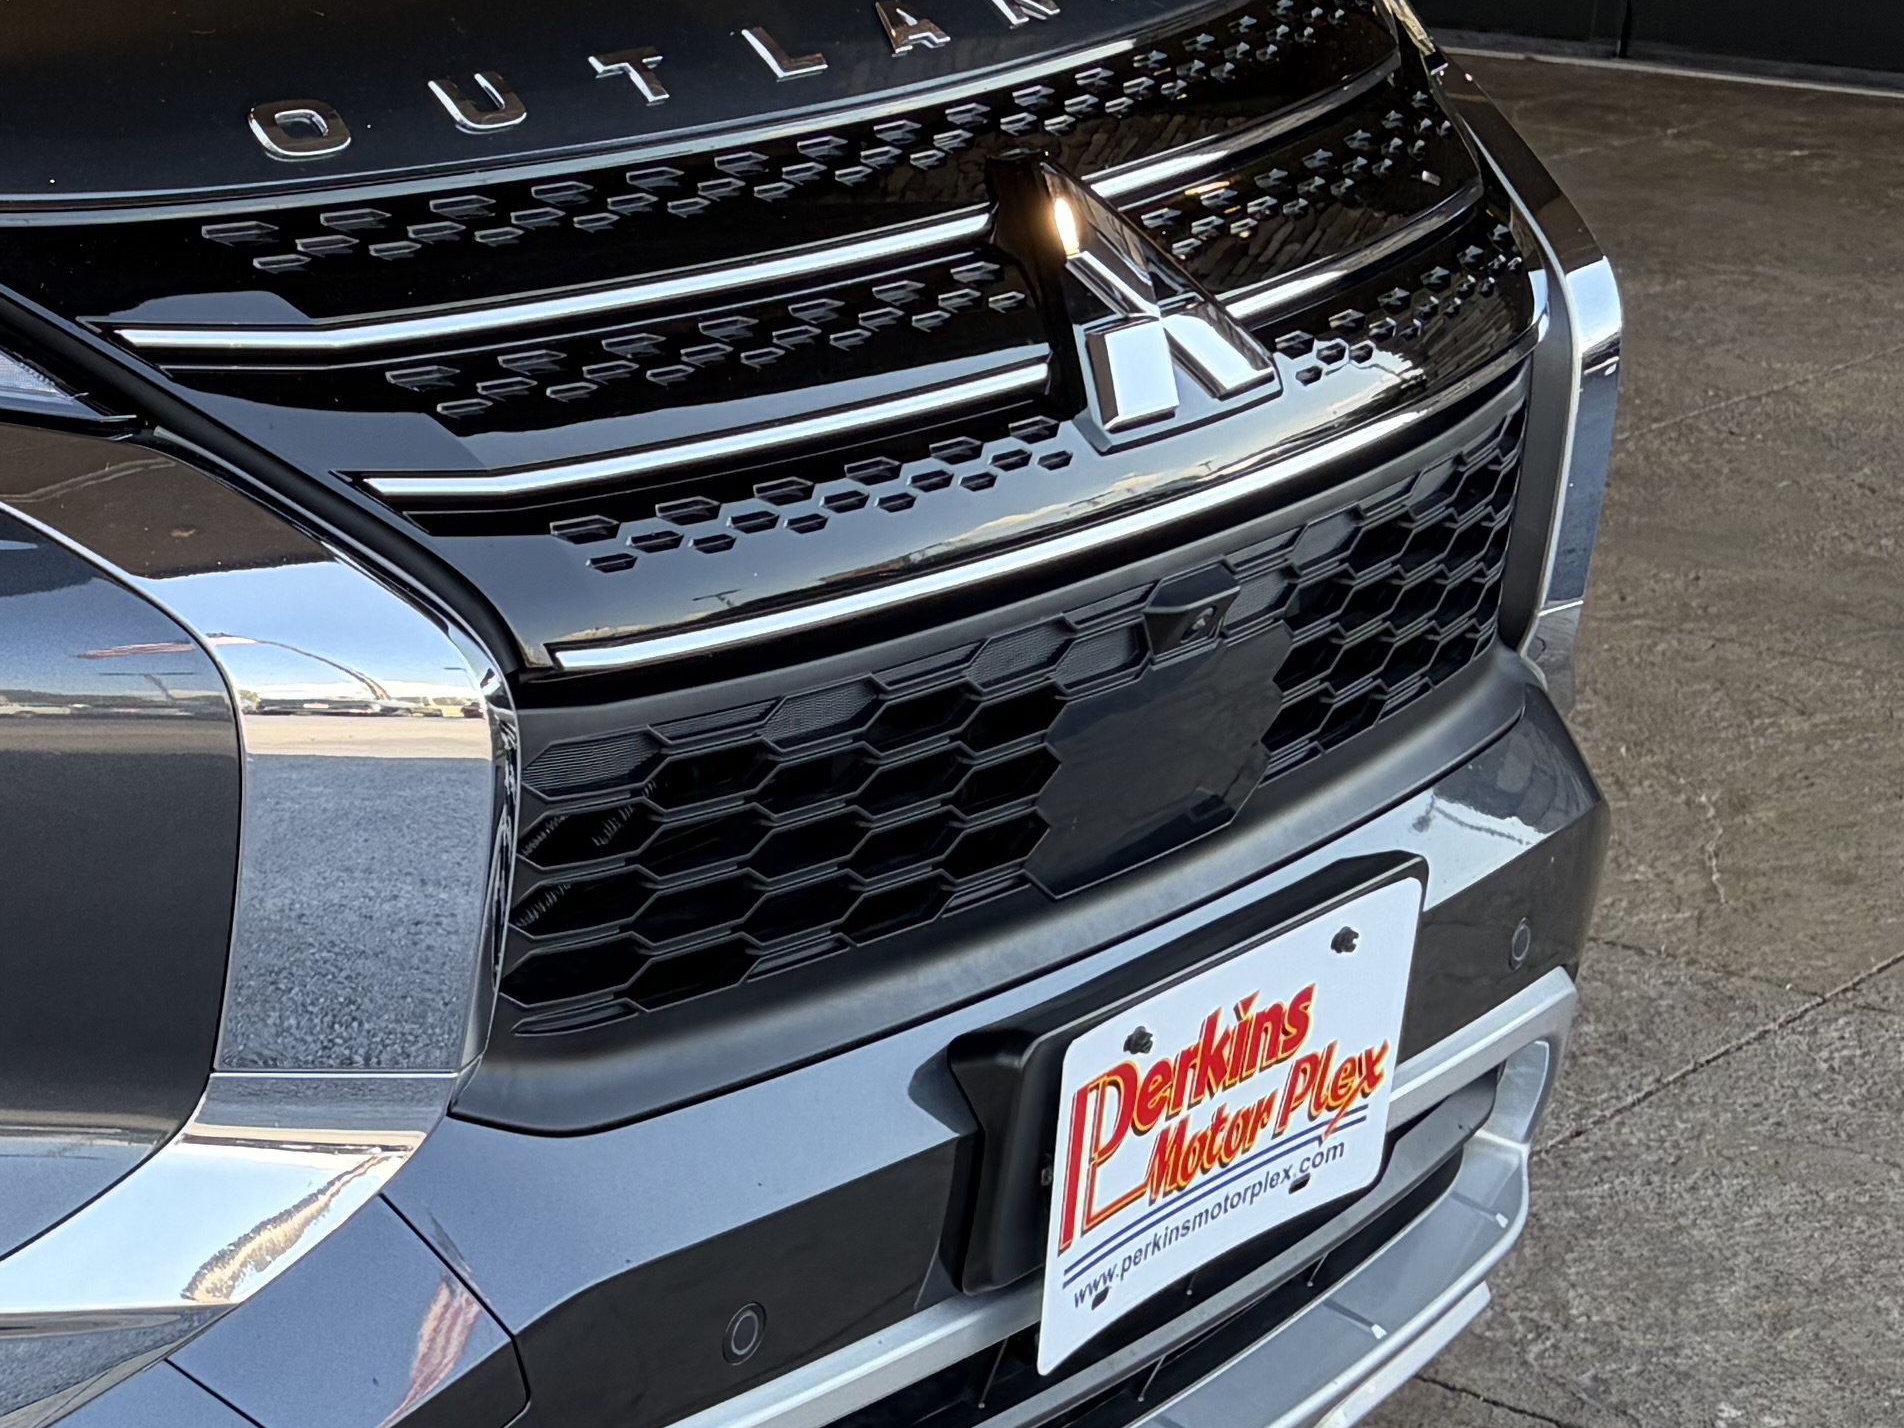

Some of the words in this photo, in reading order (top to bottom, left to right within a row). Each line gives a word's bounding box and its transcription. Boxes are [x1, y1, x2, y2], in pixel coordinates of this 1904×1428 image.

[1058, 983, 1316, 1257] Perkins
[1146, 1090, 1279, 1206] Motor
[1272, 1039, 1390, 1139] Plex
[1073, 1141, 1345, 1309] www.perkinsmotorplex.com
